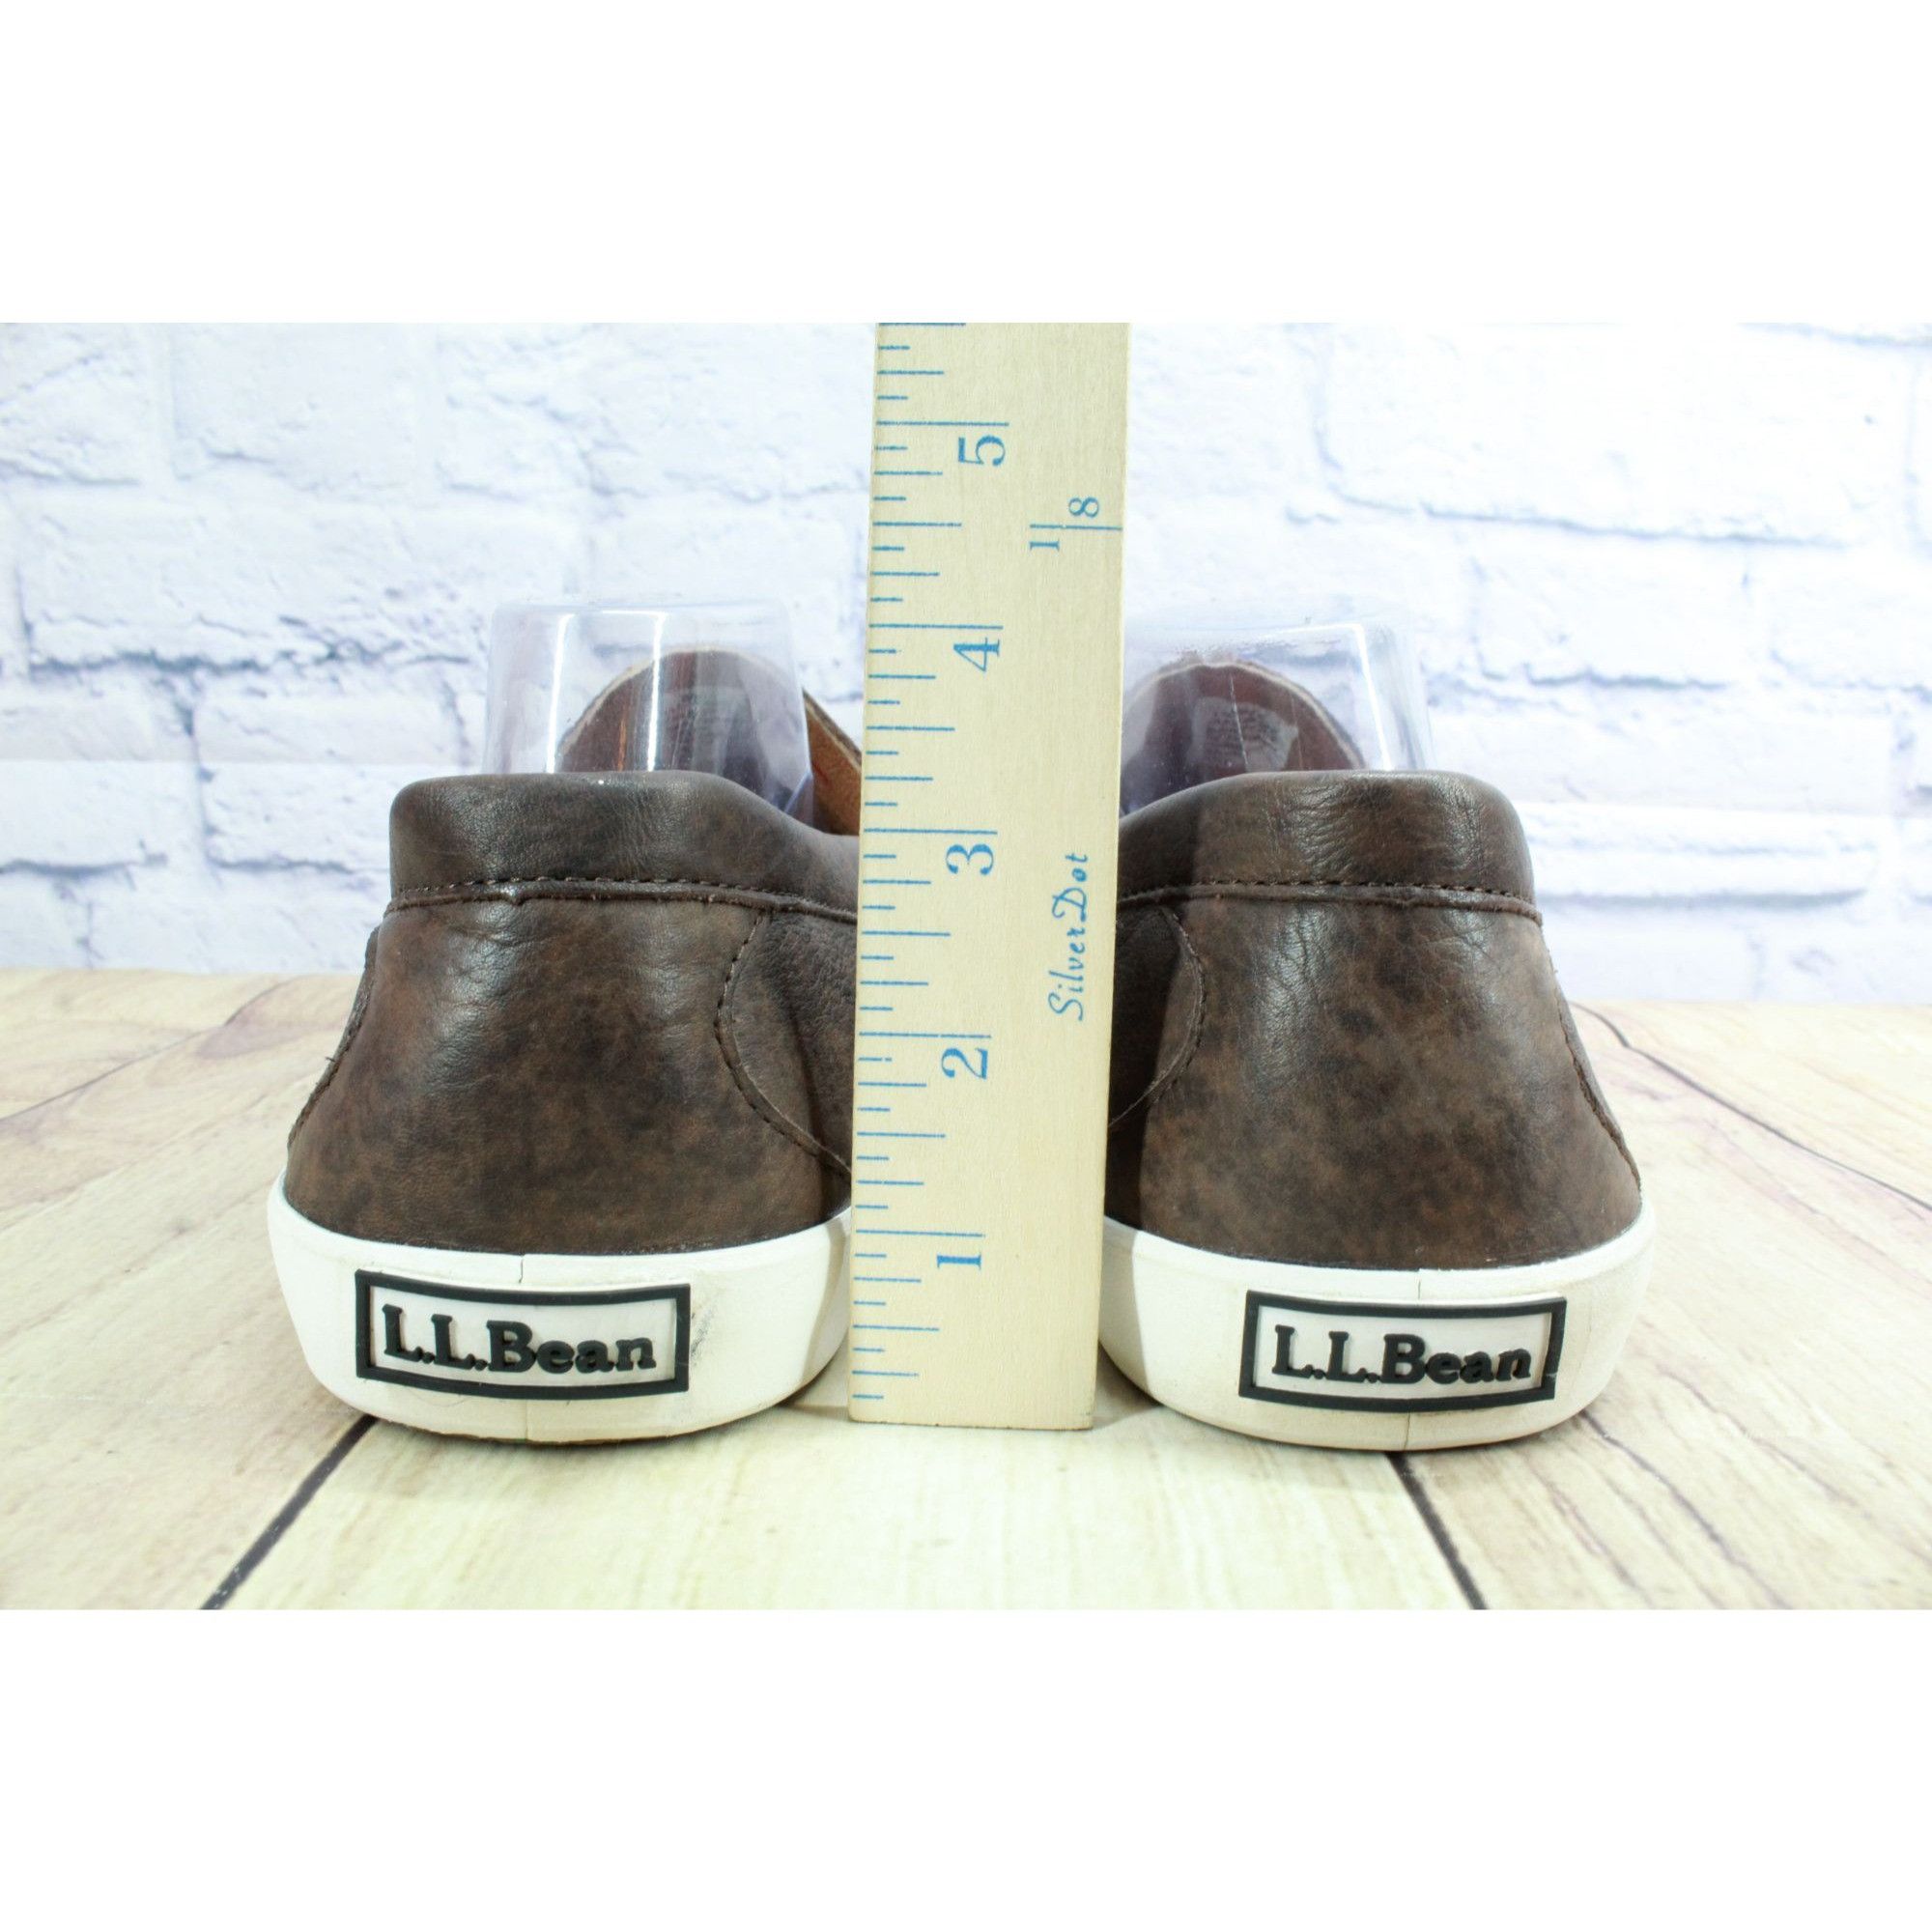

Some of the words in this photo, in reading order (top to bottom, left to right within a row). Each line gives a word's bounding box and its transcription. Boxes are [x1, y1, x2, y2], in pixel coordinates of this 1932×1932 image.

[957, 434, 1005, 467] 5
[952, 639, 1001, 673] 4
[946, 842, 994, 875] 3
[942, 1047, 988, 1081] 2
[936, 1252, 982, 1269] 1
[382, 1303, 657, 1374] L.L.Bean
[1272, 1324, 1532, 1384] L.L.Bean
